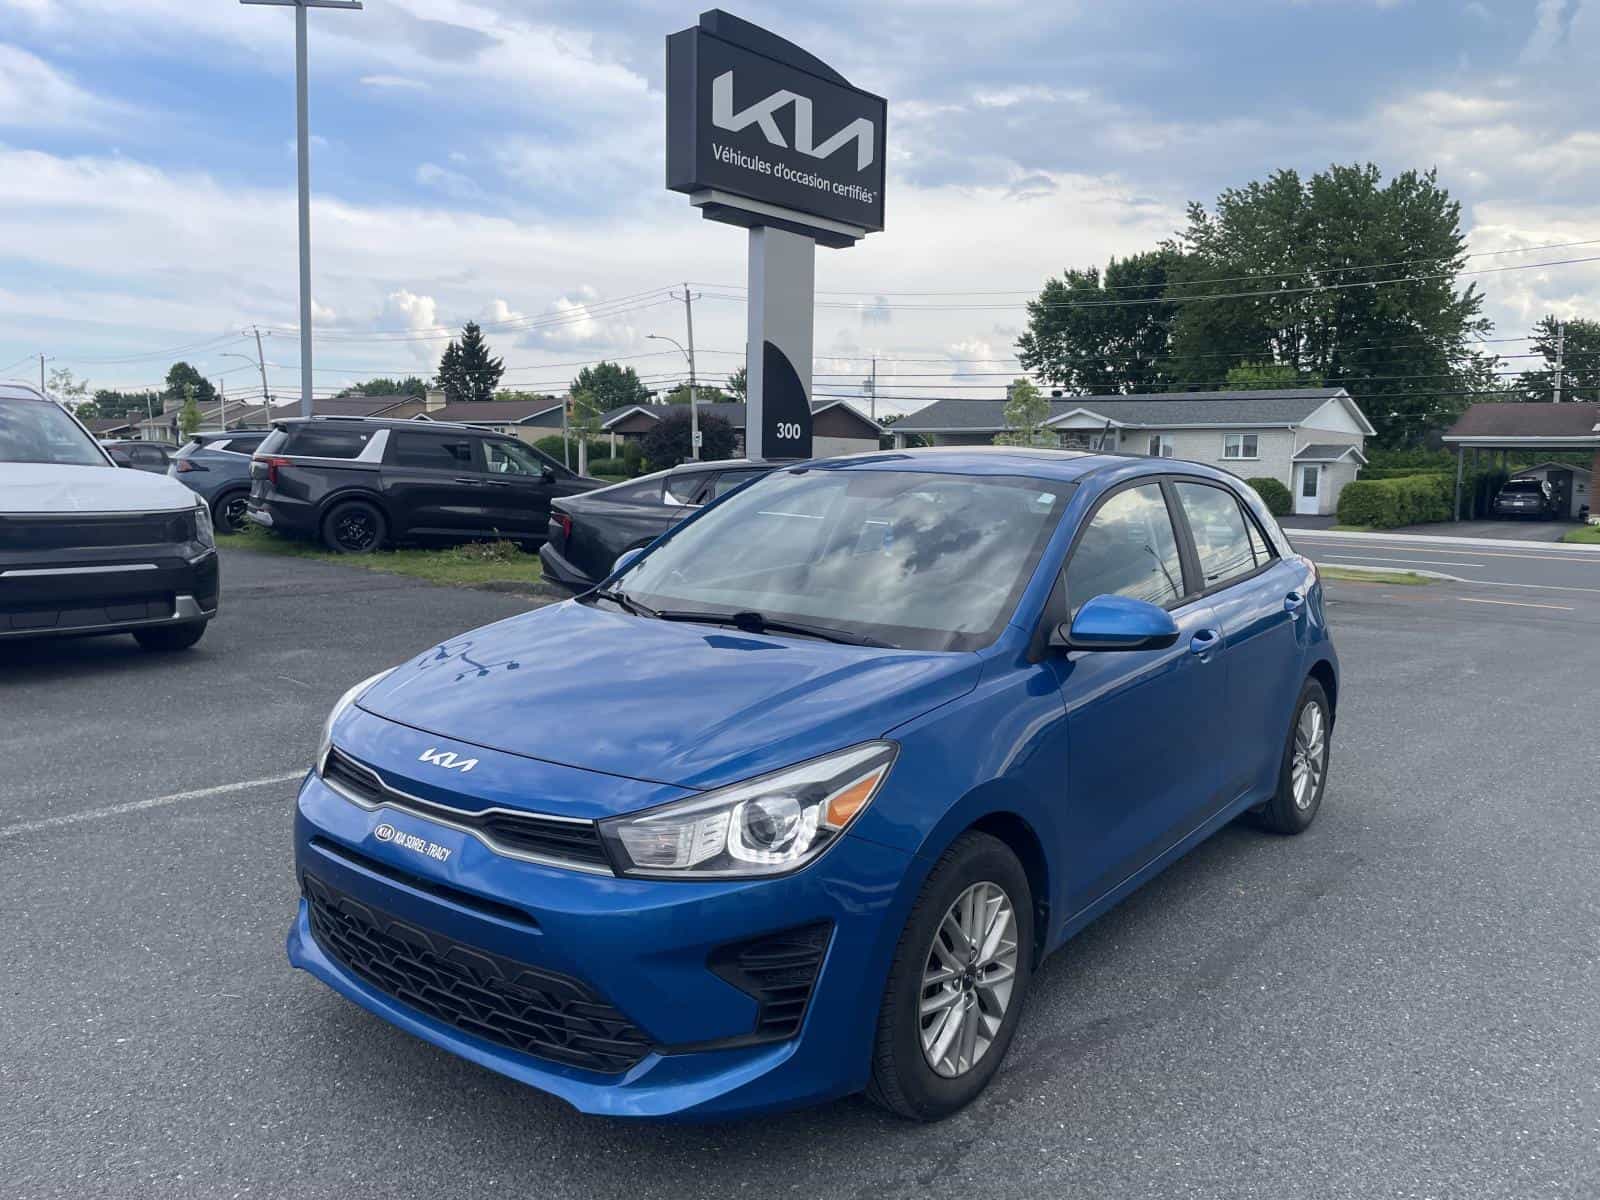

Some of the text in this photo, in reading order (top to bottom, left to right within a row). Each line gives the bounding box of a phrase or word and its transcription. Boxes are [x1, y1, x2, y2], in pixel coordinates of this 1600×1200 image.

[713, 70, 874, 172] KIA
[712, 143, 771, 175] Véhicules
[774, 163, 830, 192] d'occasion
[776, 422, 801, 440] 300
[418, 747, 479, 772] KIA
[394, 831, 452, 863] KIA SOREL-TRACY
